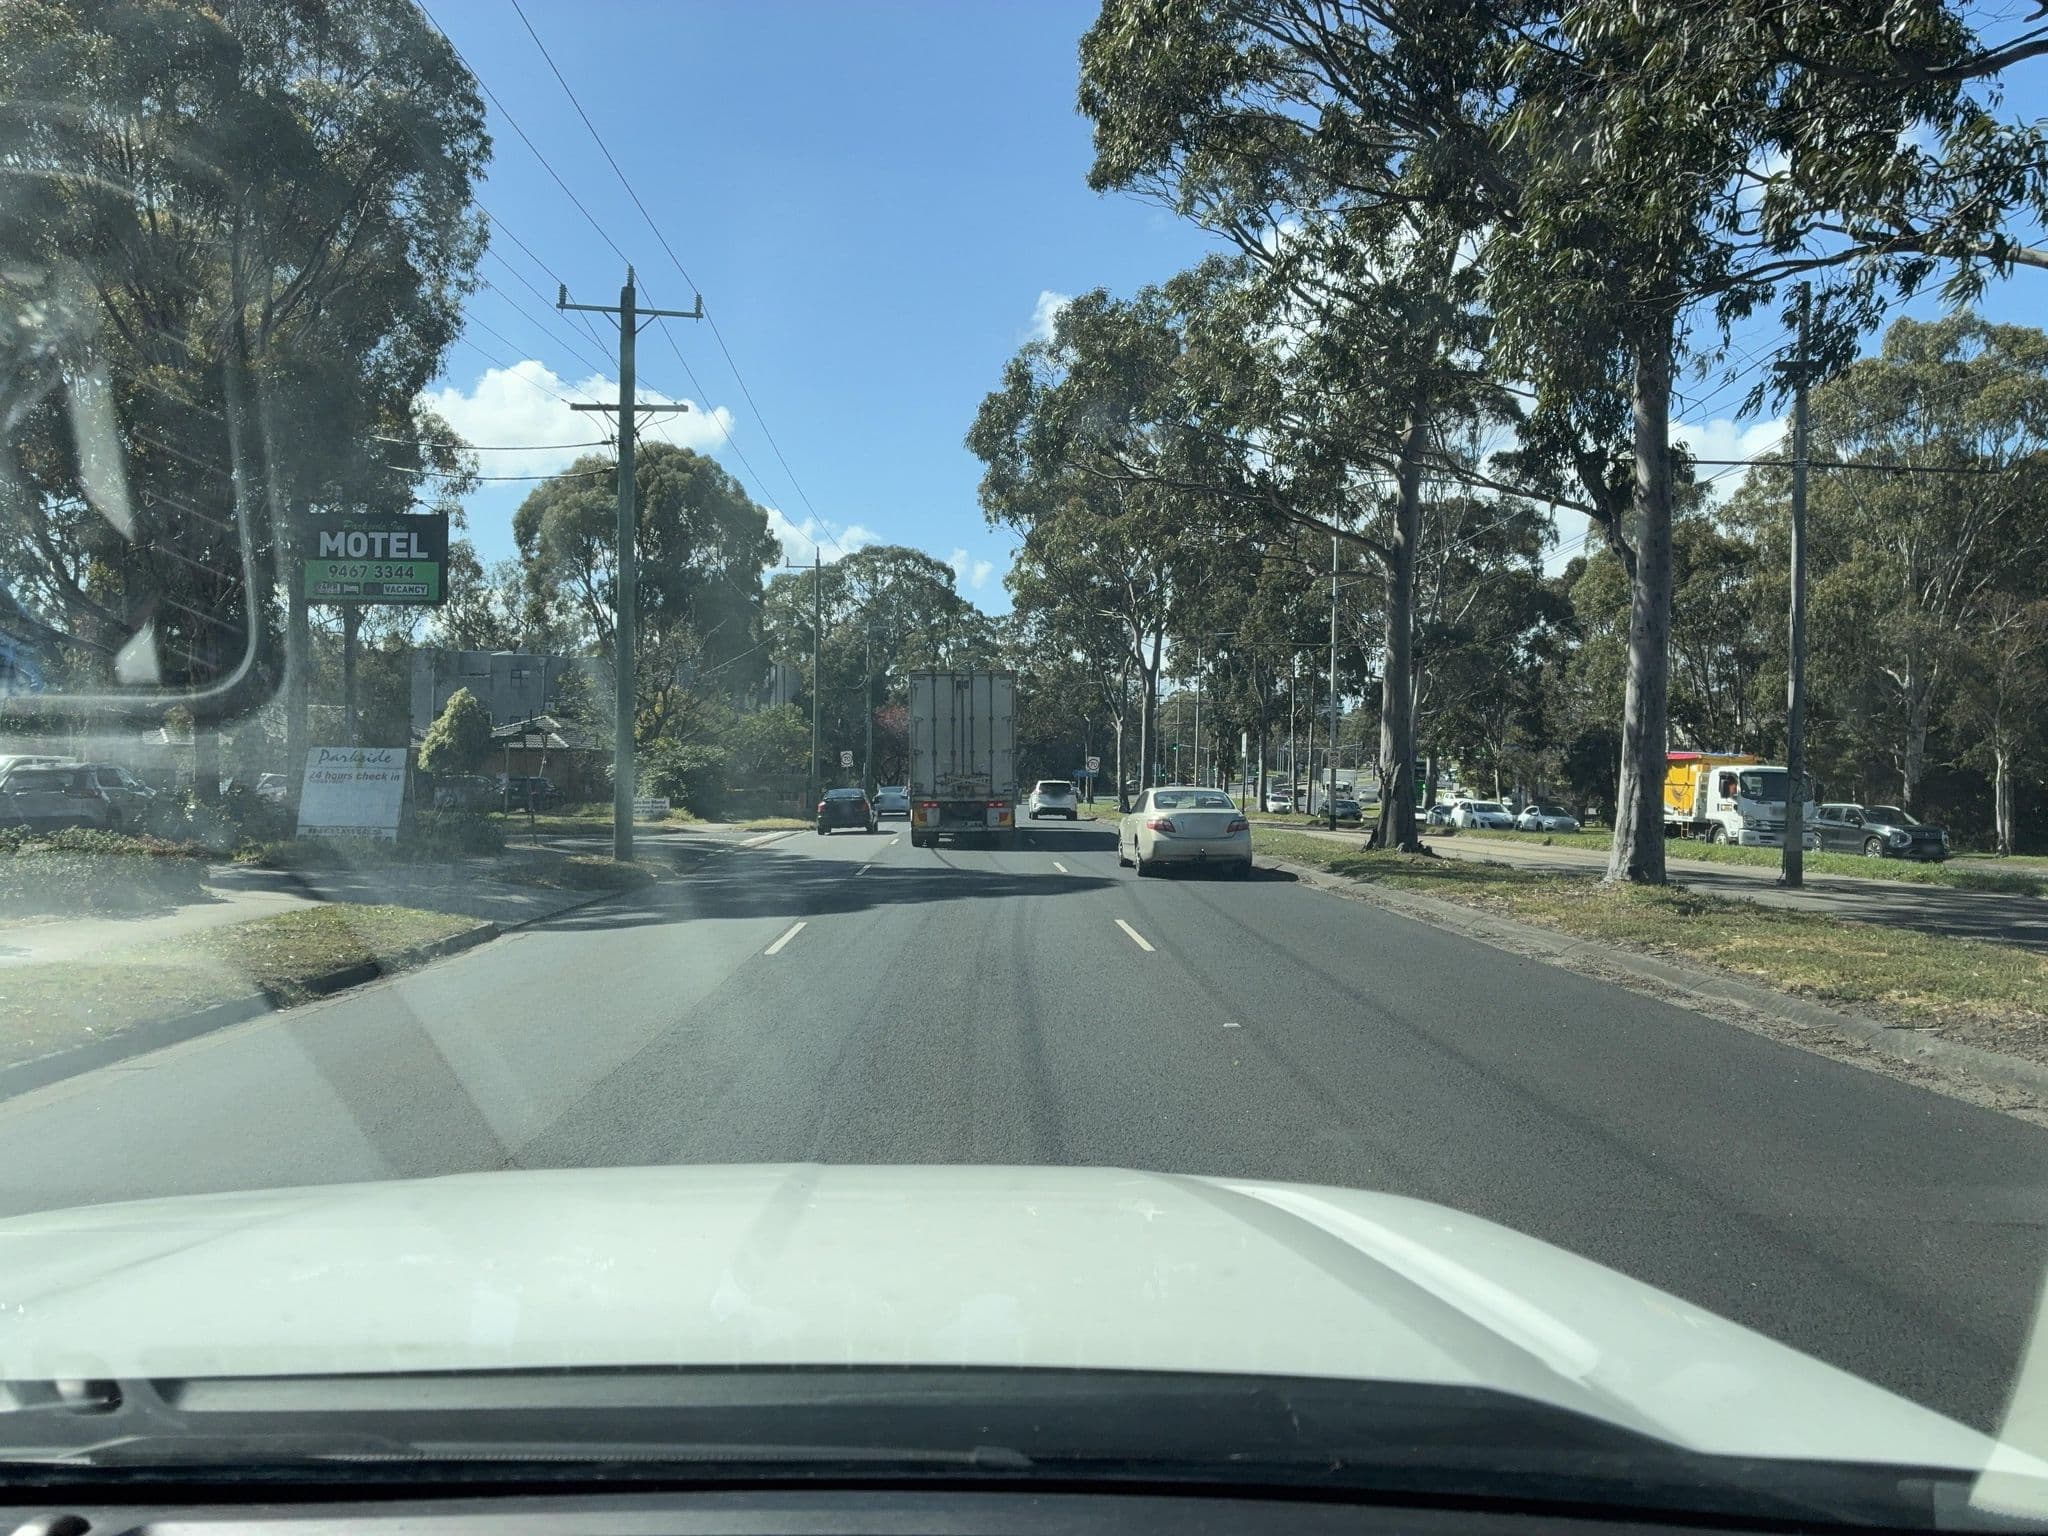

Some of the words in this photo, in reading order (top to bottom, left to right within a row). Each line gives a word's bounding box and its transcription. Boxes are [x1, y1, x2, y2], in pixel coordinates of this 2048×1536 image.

[319, 531, 429, 558] MOTEL
[328, 564, 367, 578] 9467
[374, 565, 415, 579] 3344
[384, 585, 427, 594] VACANCY
[309, 771, 322, 780] 24
[325, 770, 352, 782] hours
[356, 771, 387, 781] check
[390, 773, 400, 781] in
